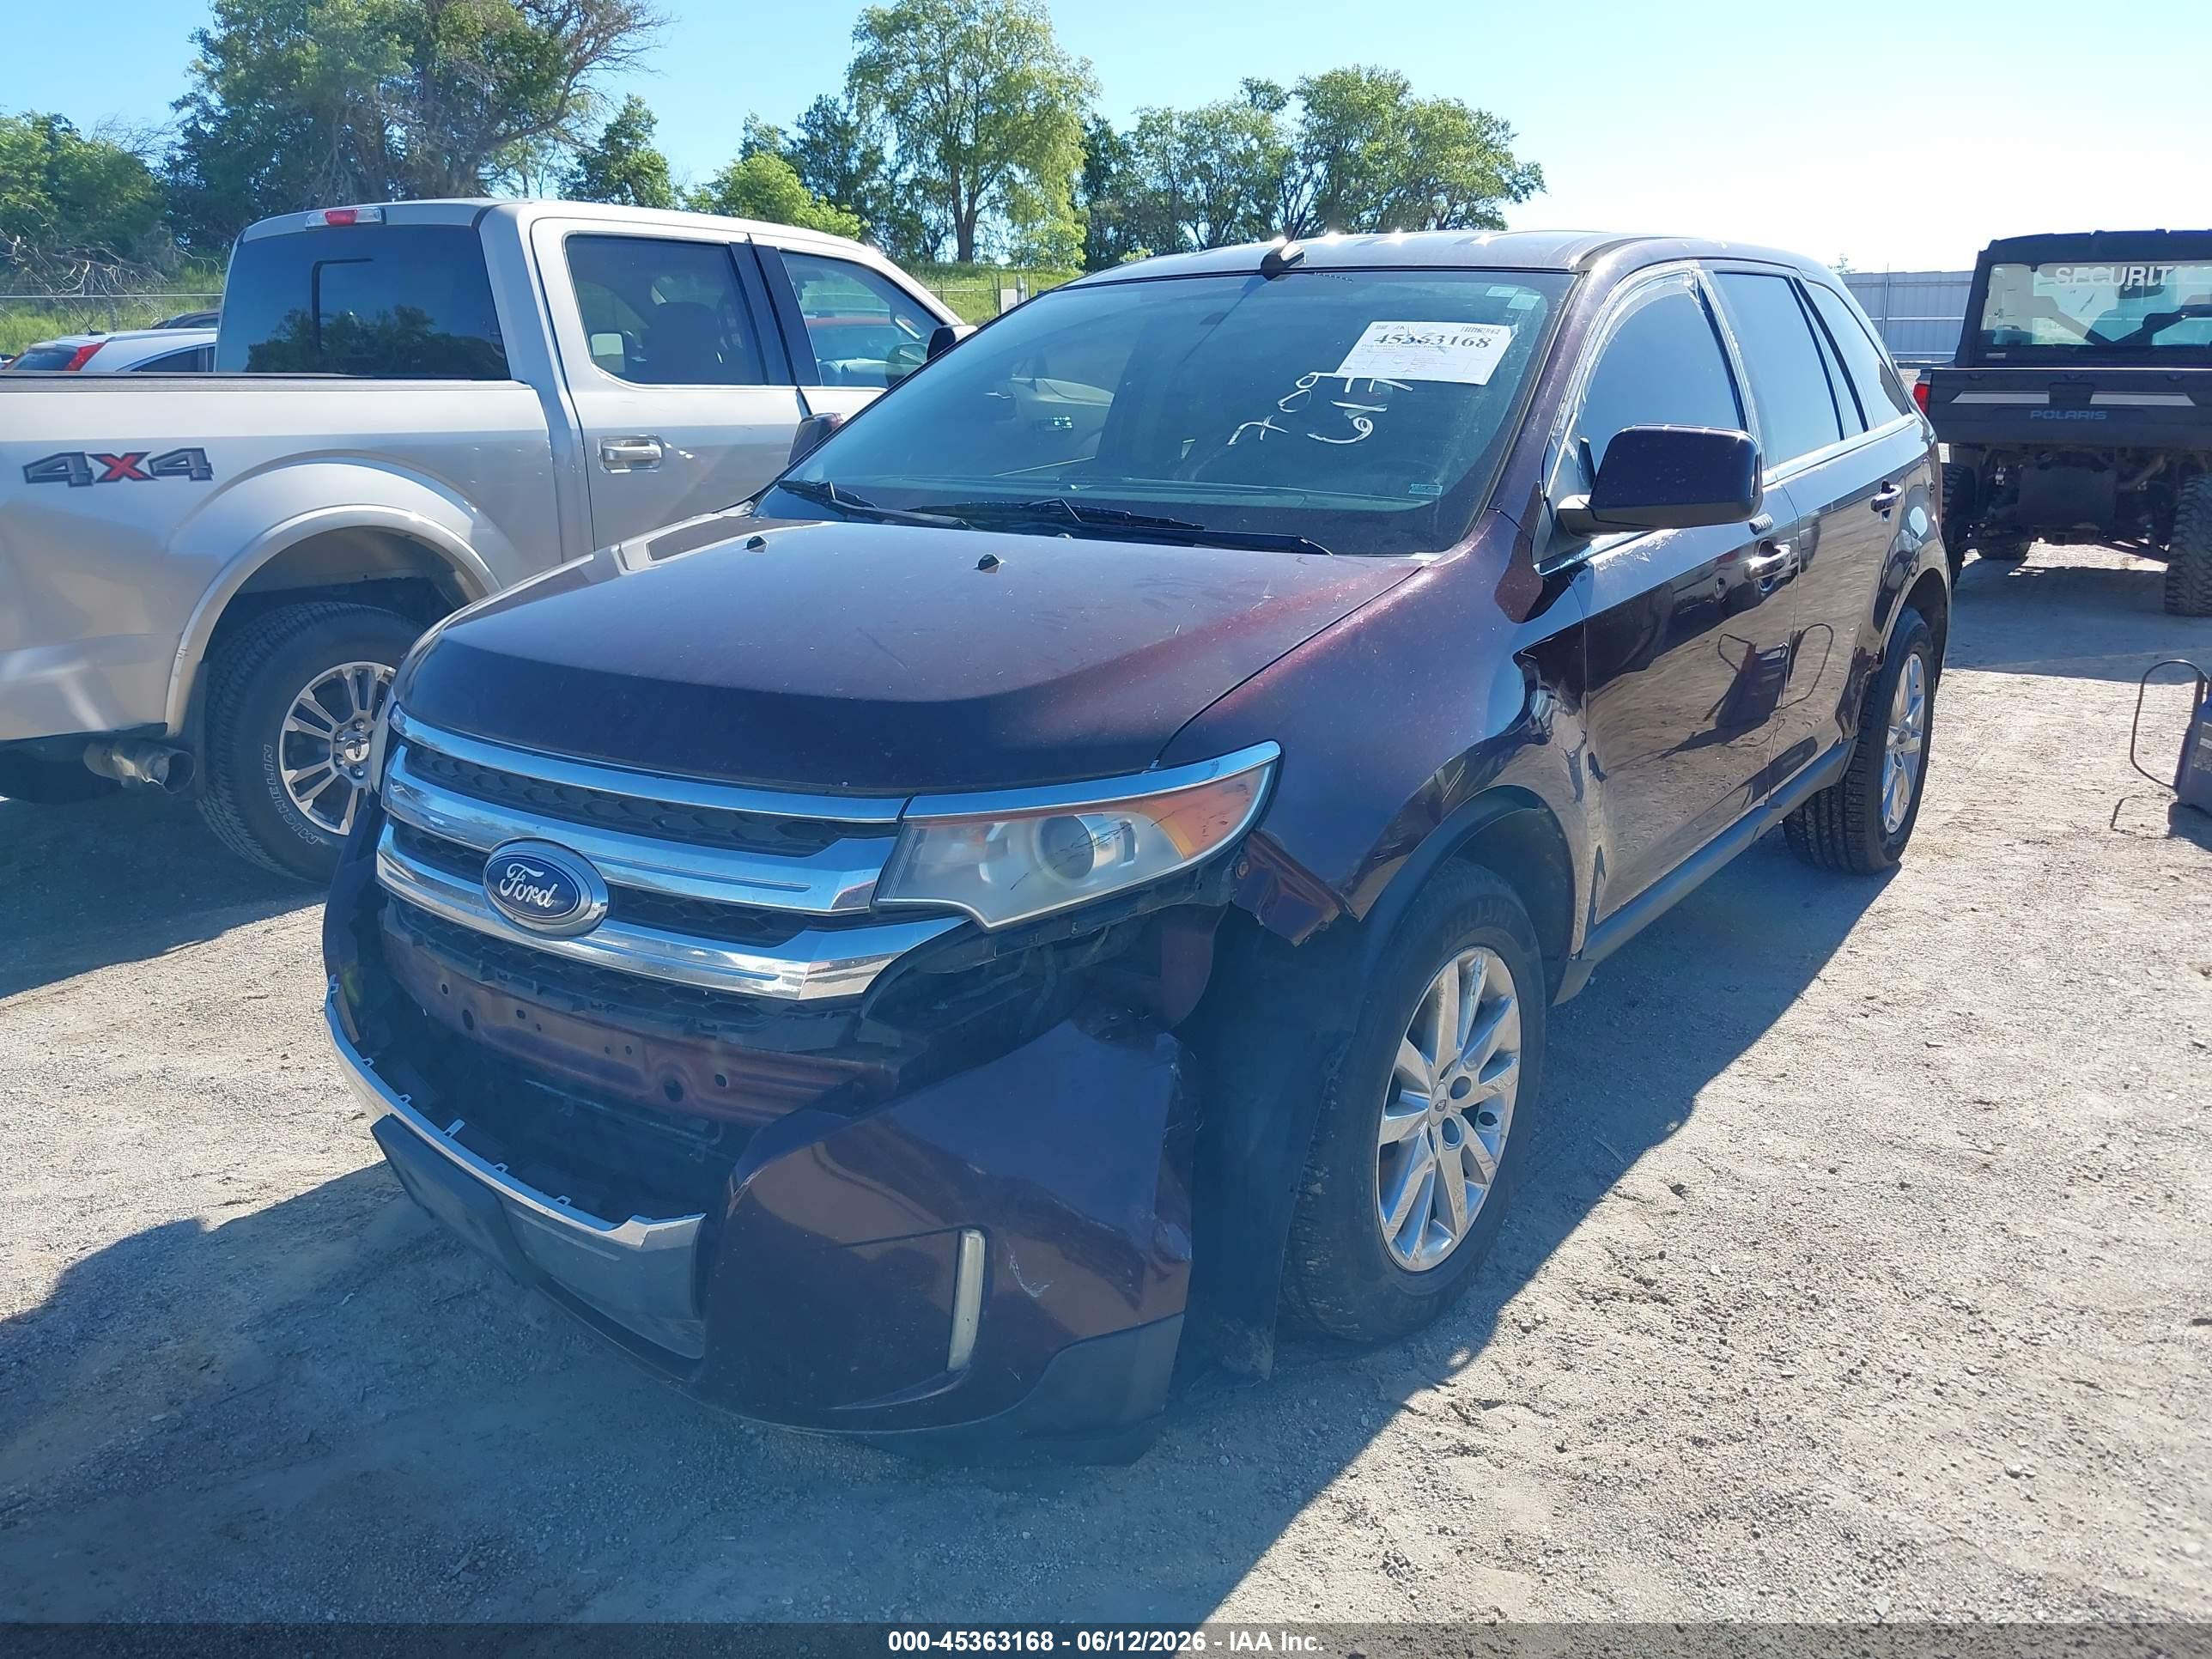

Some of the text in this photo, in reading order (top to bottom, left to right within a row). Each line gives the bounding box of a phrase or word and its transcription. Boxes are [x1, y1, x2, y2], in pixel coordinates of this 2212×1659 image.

[2055, 265, 2192, 288] SECURIT
[1374, 332, 1492, 349] 45363168
[2029, 410, 2108, 420] POLARIS
[262, 744, 319, 845] MICHELIN
[499, 862, 559, 908] Ford
